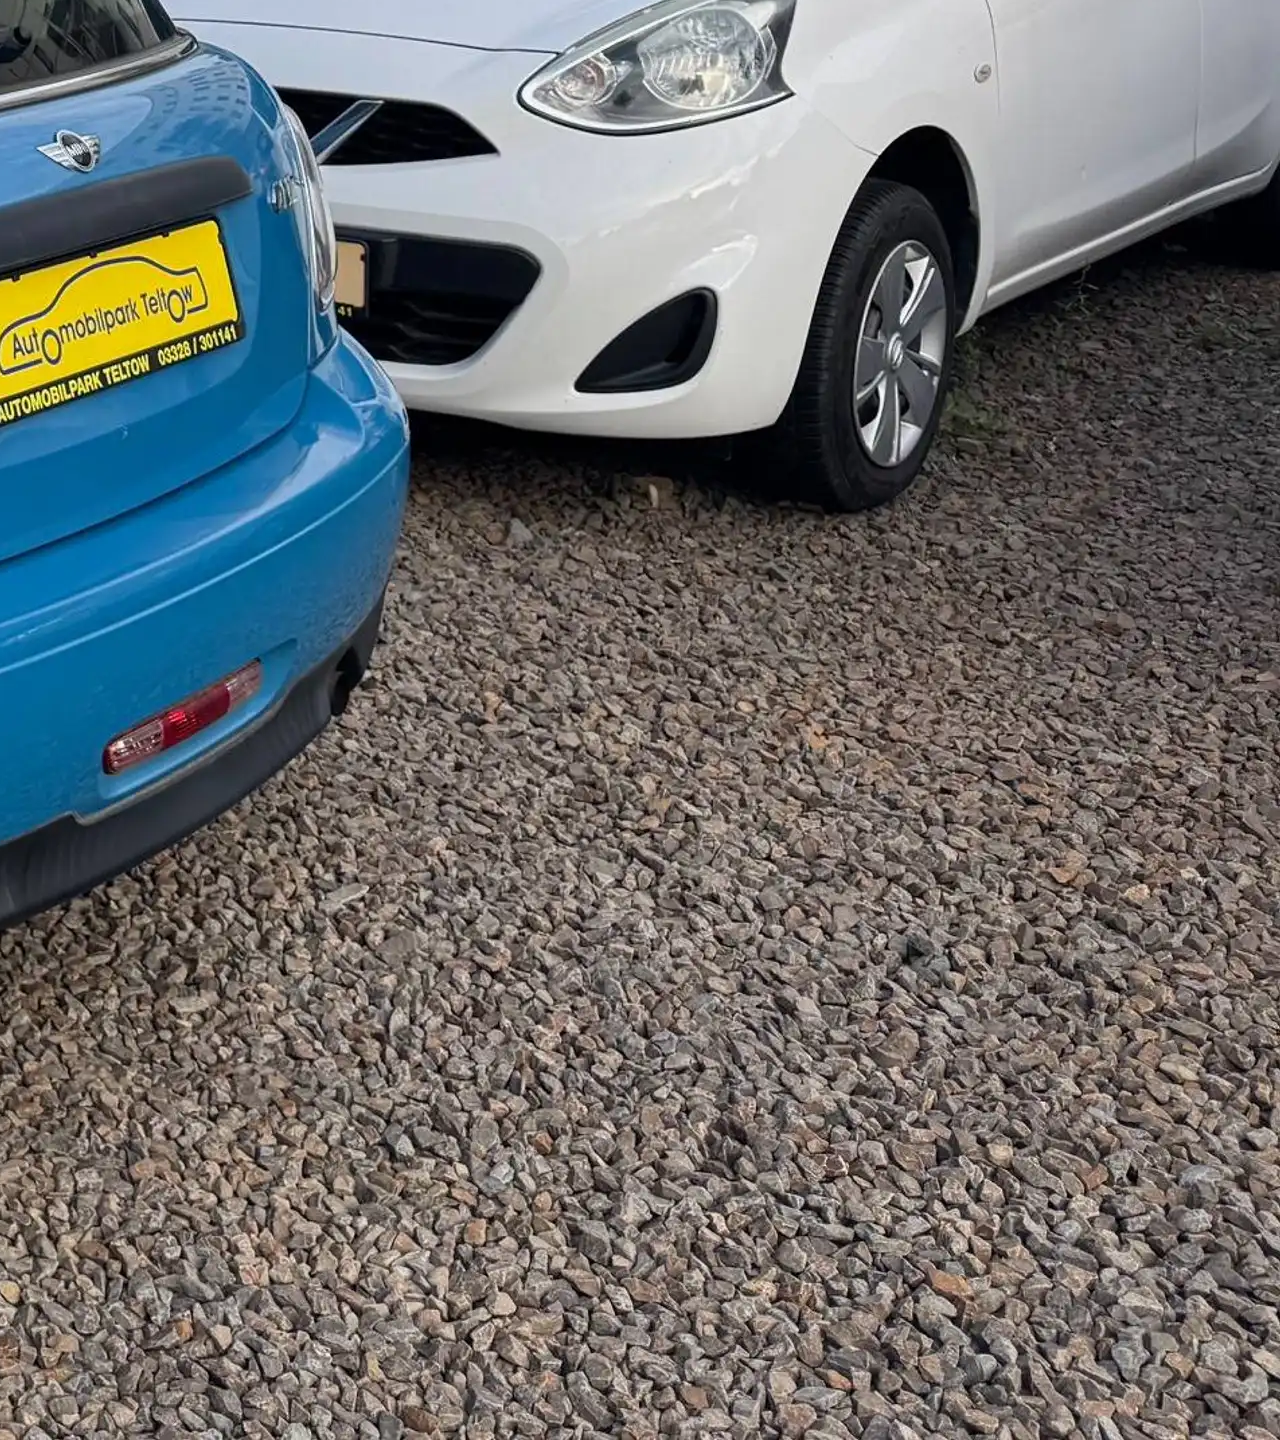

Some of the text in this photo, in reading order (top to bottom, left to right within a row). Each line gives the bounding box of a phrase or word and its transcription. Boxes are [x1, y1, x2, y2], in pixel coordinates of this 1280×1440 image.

[12, 285, 193, 365] Automobilpark Teltow
[103, 354, 151, 386] TELTOW
[157, 340, 192, 366] 03328
[200, 325, 237, 352] 301141
